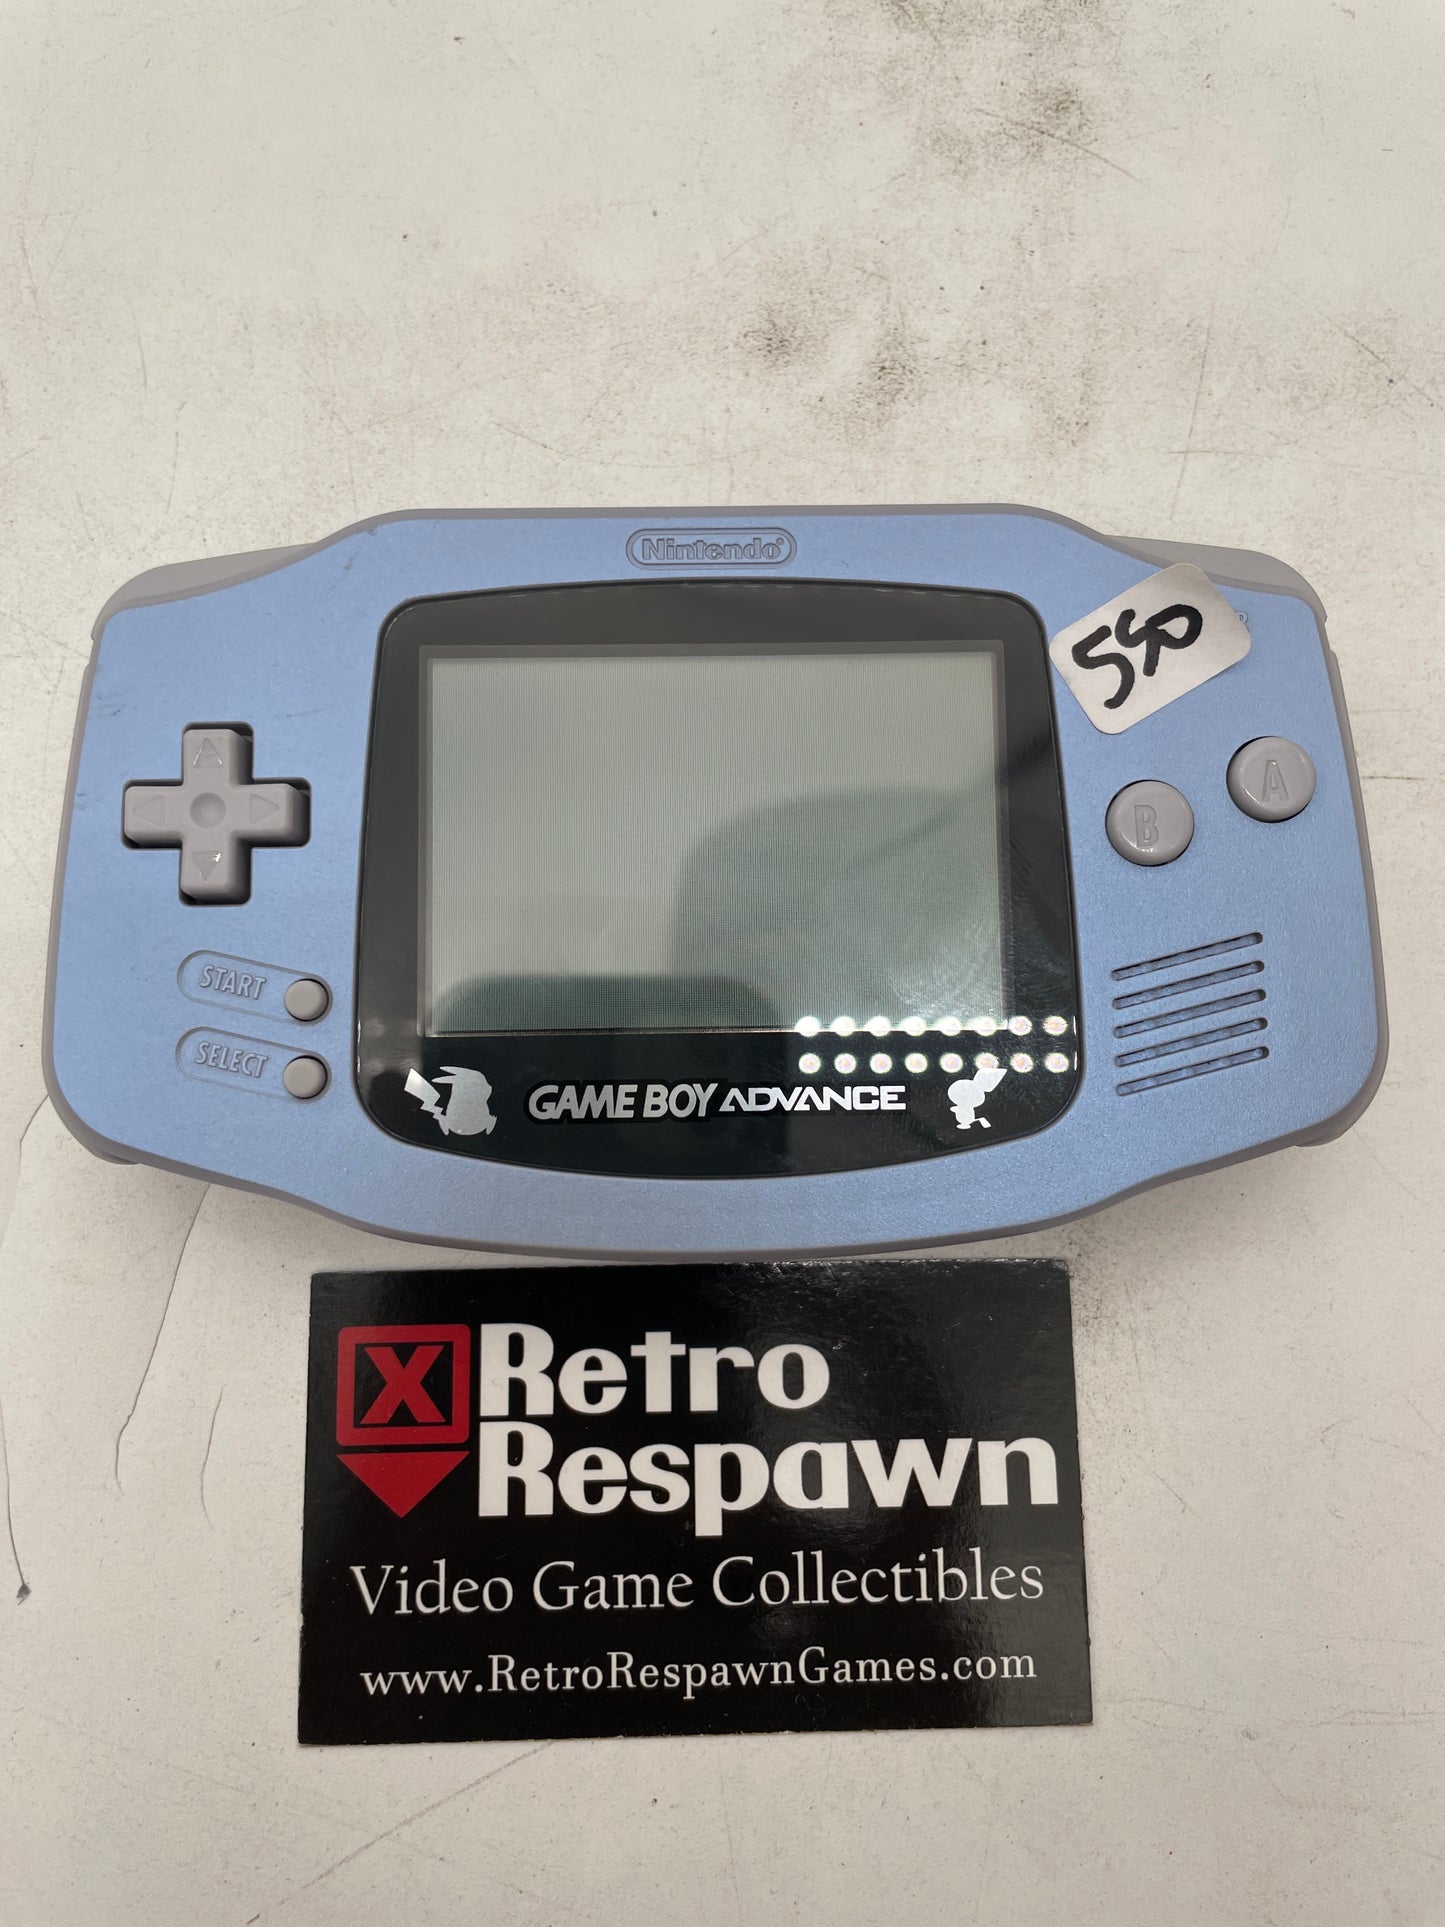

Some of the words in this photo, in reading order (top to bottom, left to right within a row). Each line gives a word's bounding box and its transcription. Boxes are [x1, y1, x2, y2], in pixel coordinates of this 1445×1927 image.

[1261, 759, 1290, 802] A
[1134, 804, 1160, 848] B
[200, 964, 268, 1000] START
[195, 1041, 269, 1078] SELECT
[528, 1084, 637, 1119] GAME
[643, 1083, 718, 1118] BOY
[719, 1085, 907, 1112] ADVANCE
[479, 1322, 831, 1416] Retro
[478, 1420, 1059, 1537] Respawn
[349, 1560, 514, 1616] Video
[532, 1560, 694, 1610] Game
[712, 1547, 1045, 1606] Collectibles
[360, 1646, 1038, 1699] www.RetroRespawnGames.com
